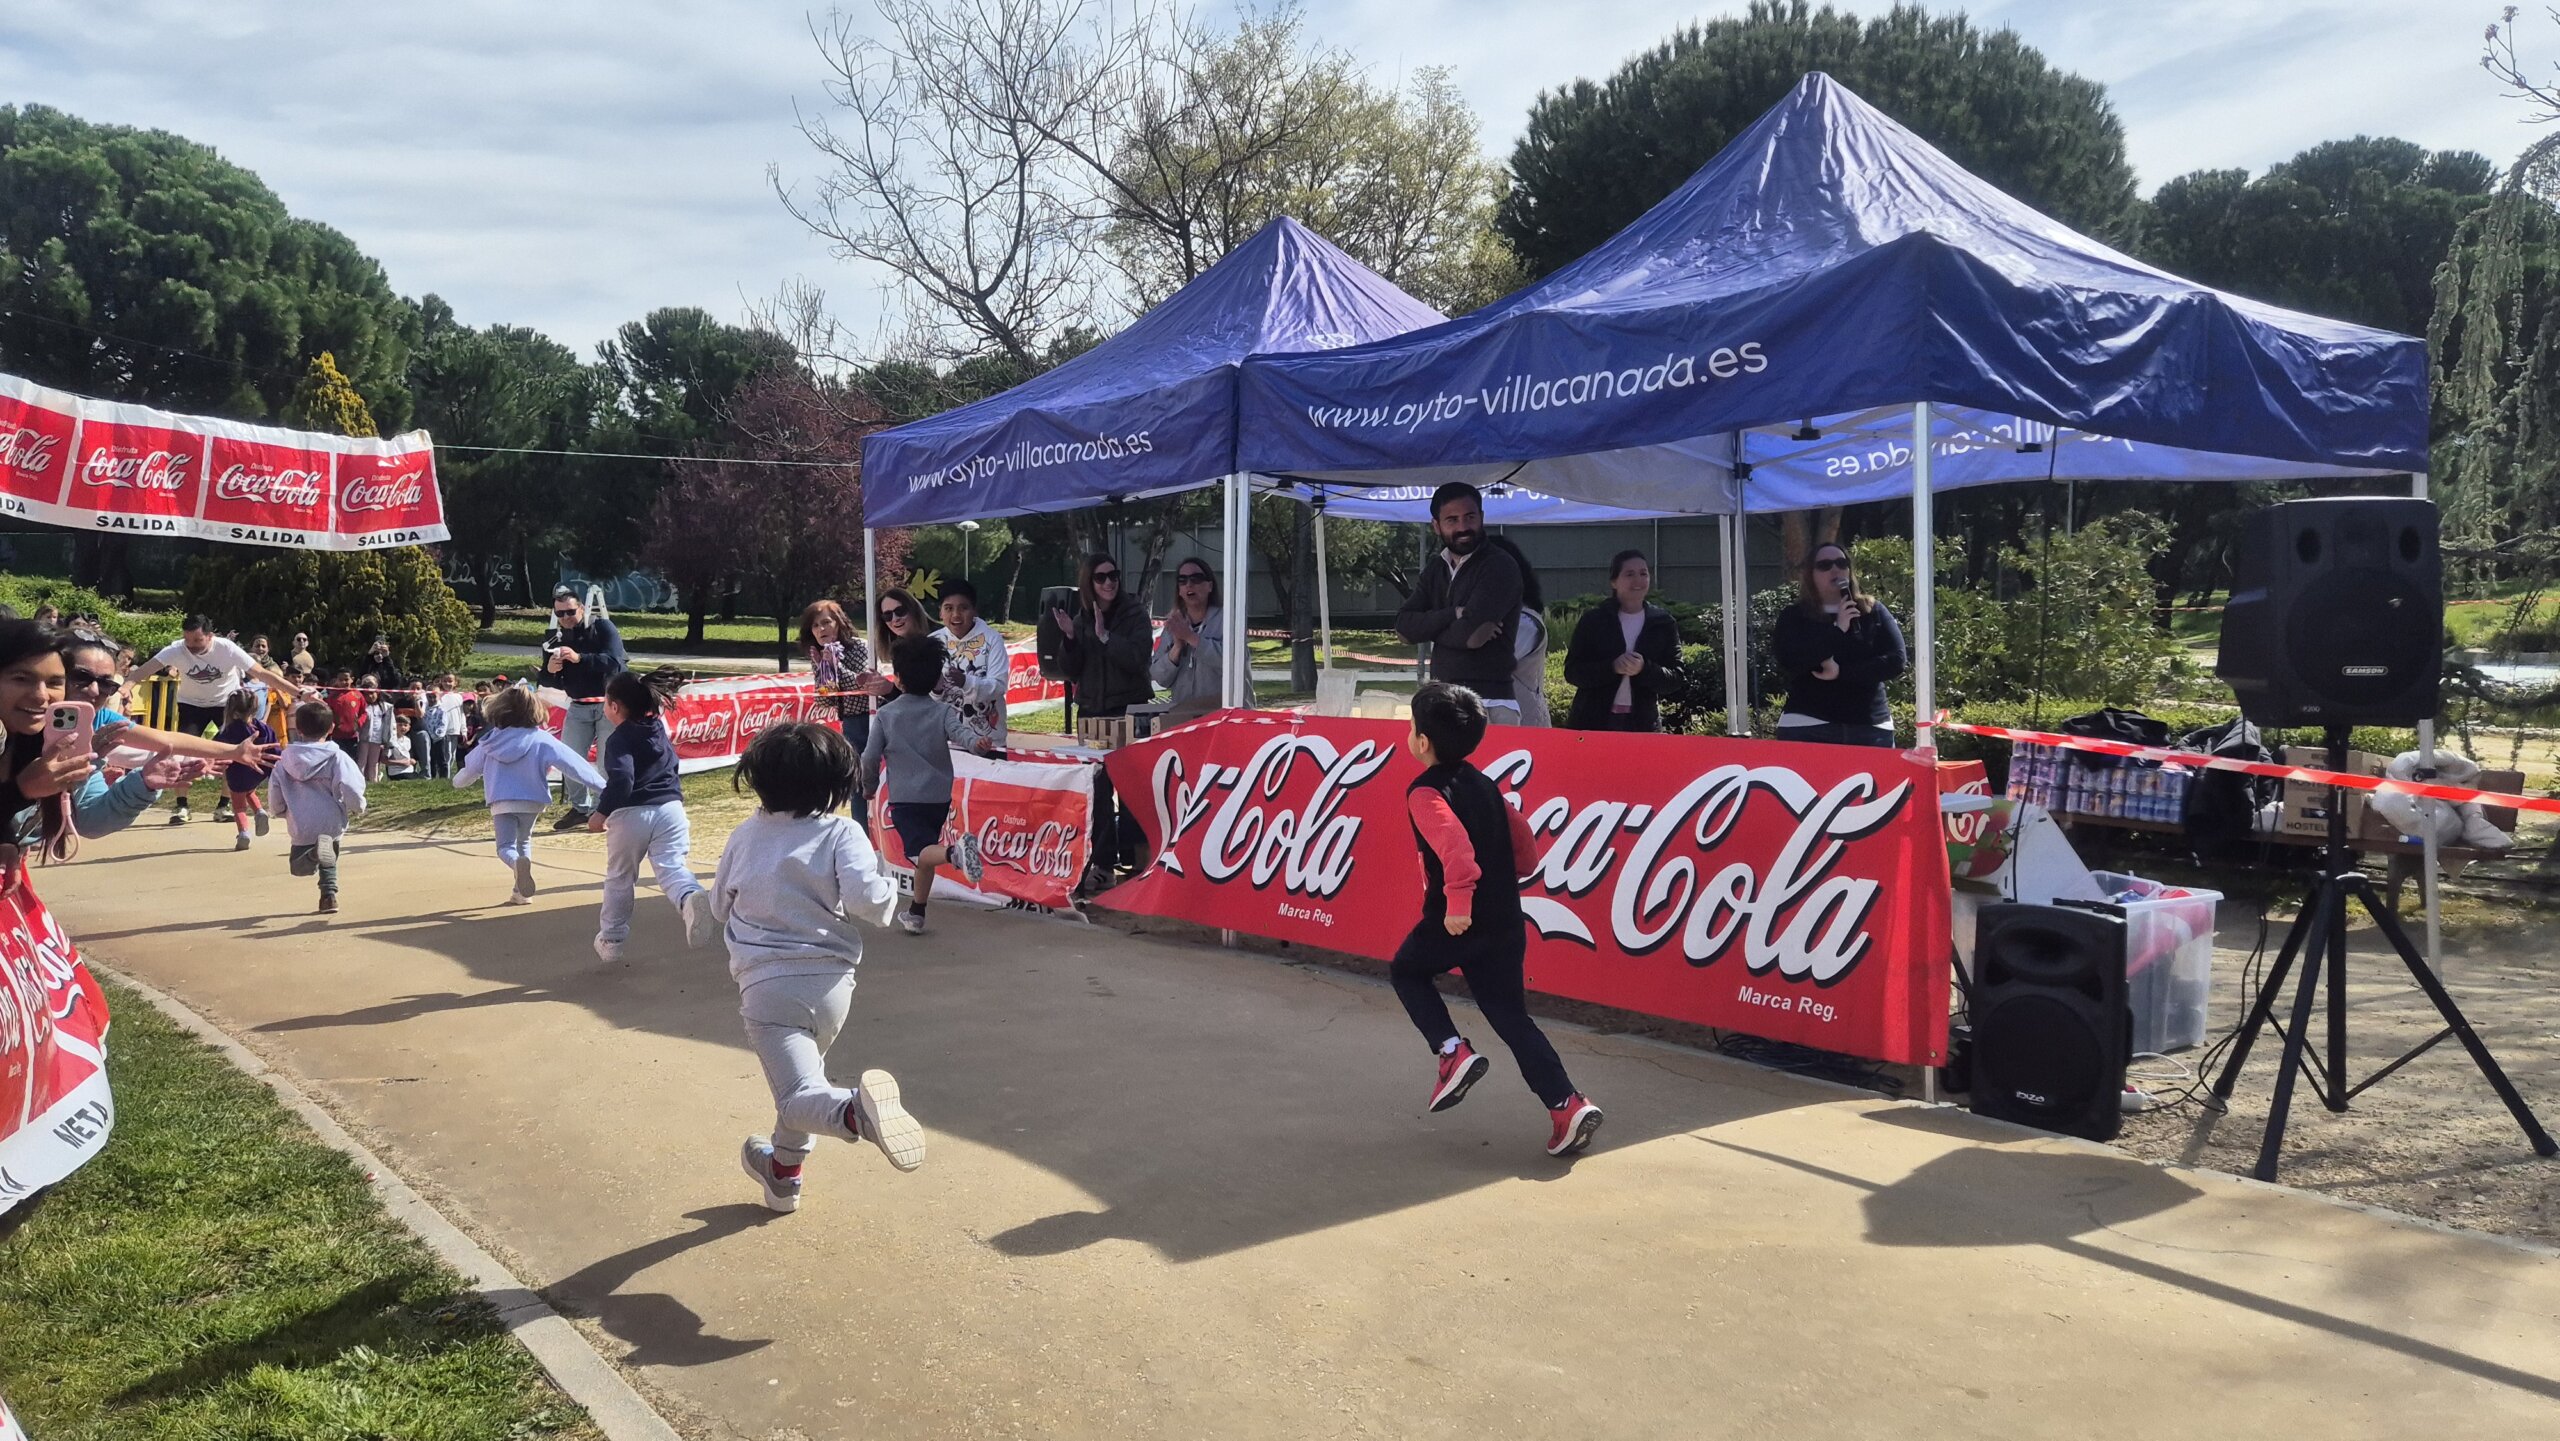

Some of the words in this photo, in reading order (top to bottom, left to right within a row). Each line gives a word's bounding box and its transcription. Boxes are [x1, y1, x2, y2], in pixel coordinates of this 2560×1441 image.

[1308, 342, 1768, 434] www.ayto-villacanada.es
[82, 447, 193, 490] Coca-Cola
[908, 431, 1152, 493] www.ayto-villacanada.es
[216, 464, 323, 506] Coca-Cola
[341, 469, 424, 512] Coca-Cola
[96, 515, 175, 531] SALIDA
[230, 528, 306, 544] SALIDA
[358, 531, 421, 547] SALIDA
[671, 711, 732, 745] Coca-Cola
[1003, 814, 1027, 826] Disfruta
[978, 815, 1079, 878] Coca-Cola
[1278, 902, 1311, 920] Marca
[1312, 908, 1335, 927] Reg.
[1738, 985, 1793, 1011] Marca
[1797, 996, 1838, 1022] Reg.
